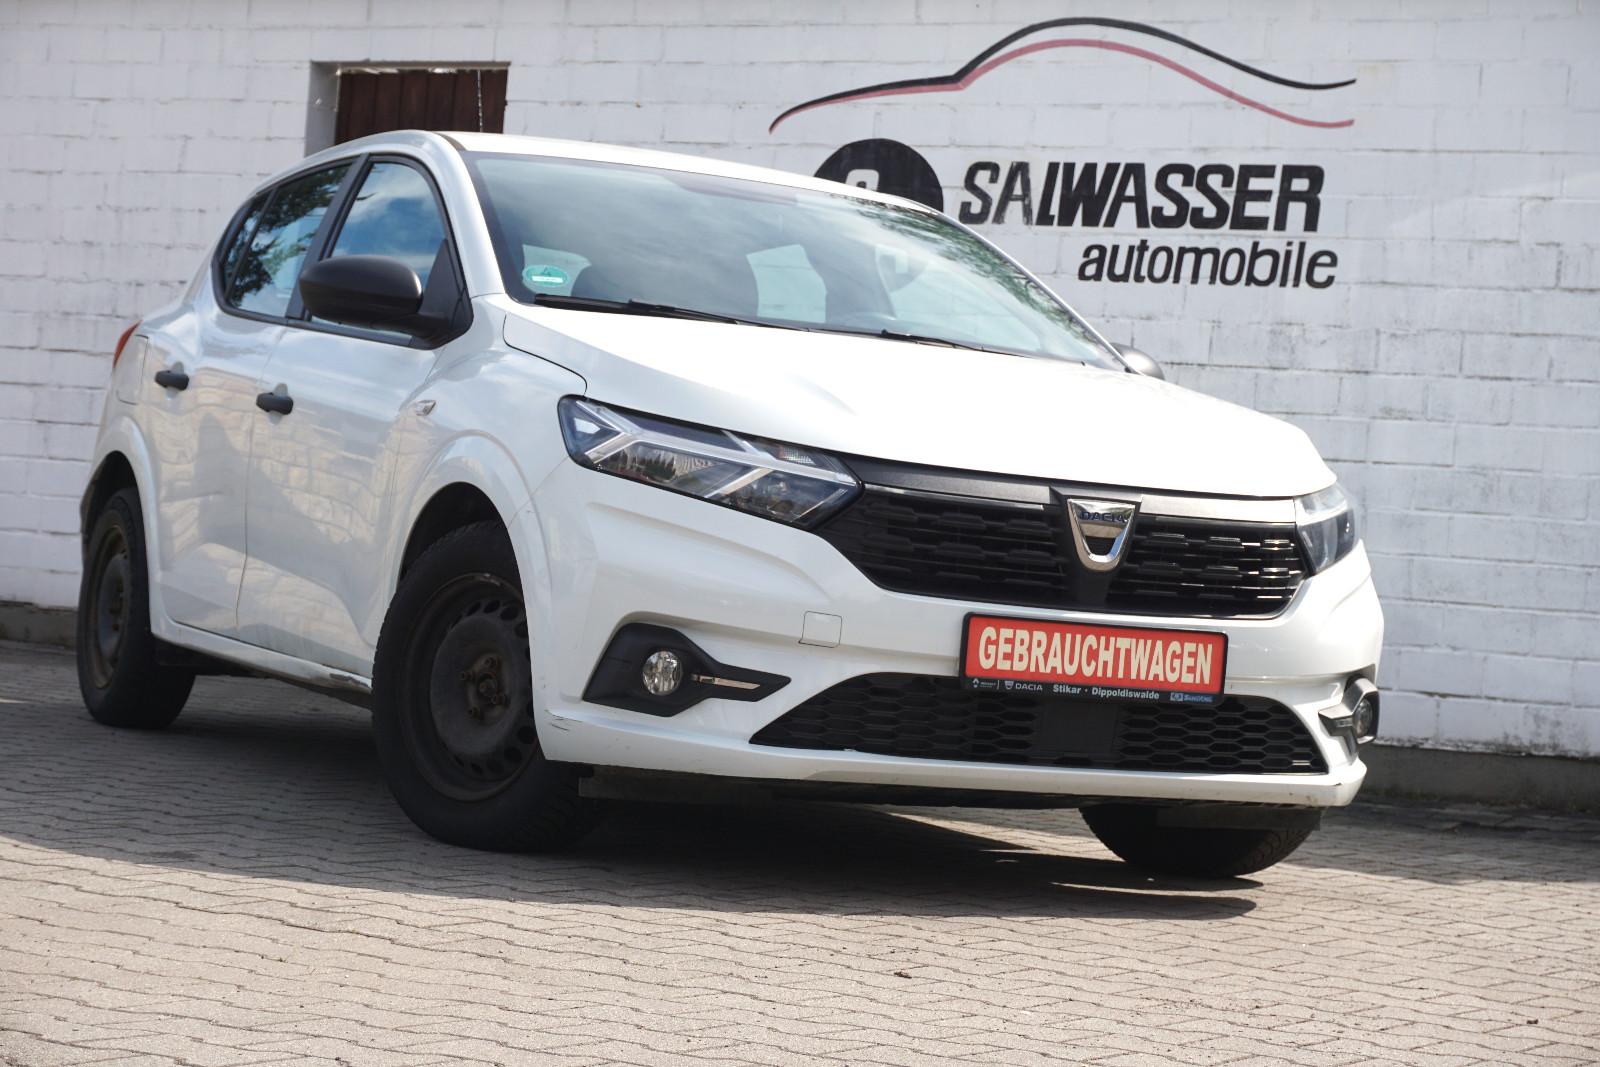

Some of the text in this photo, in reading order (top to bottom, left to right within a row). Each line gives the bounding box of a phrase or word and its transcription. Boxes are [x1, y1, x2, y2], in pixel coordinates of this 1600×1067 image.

[959, 161, 1325, 232] SALWASSER
[1078, 240, 1338, 289] automobile
[1081, 511, 1125, 522] DACIA
[979, 626, 1213, 685] GEBRAUCHTWAGEN
[1015, 682, 1160, 700] DACIA Stikar Dippoldiswalde
